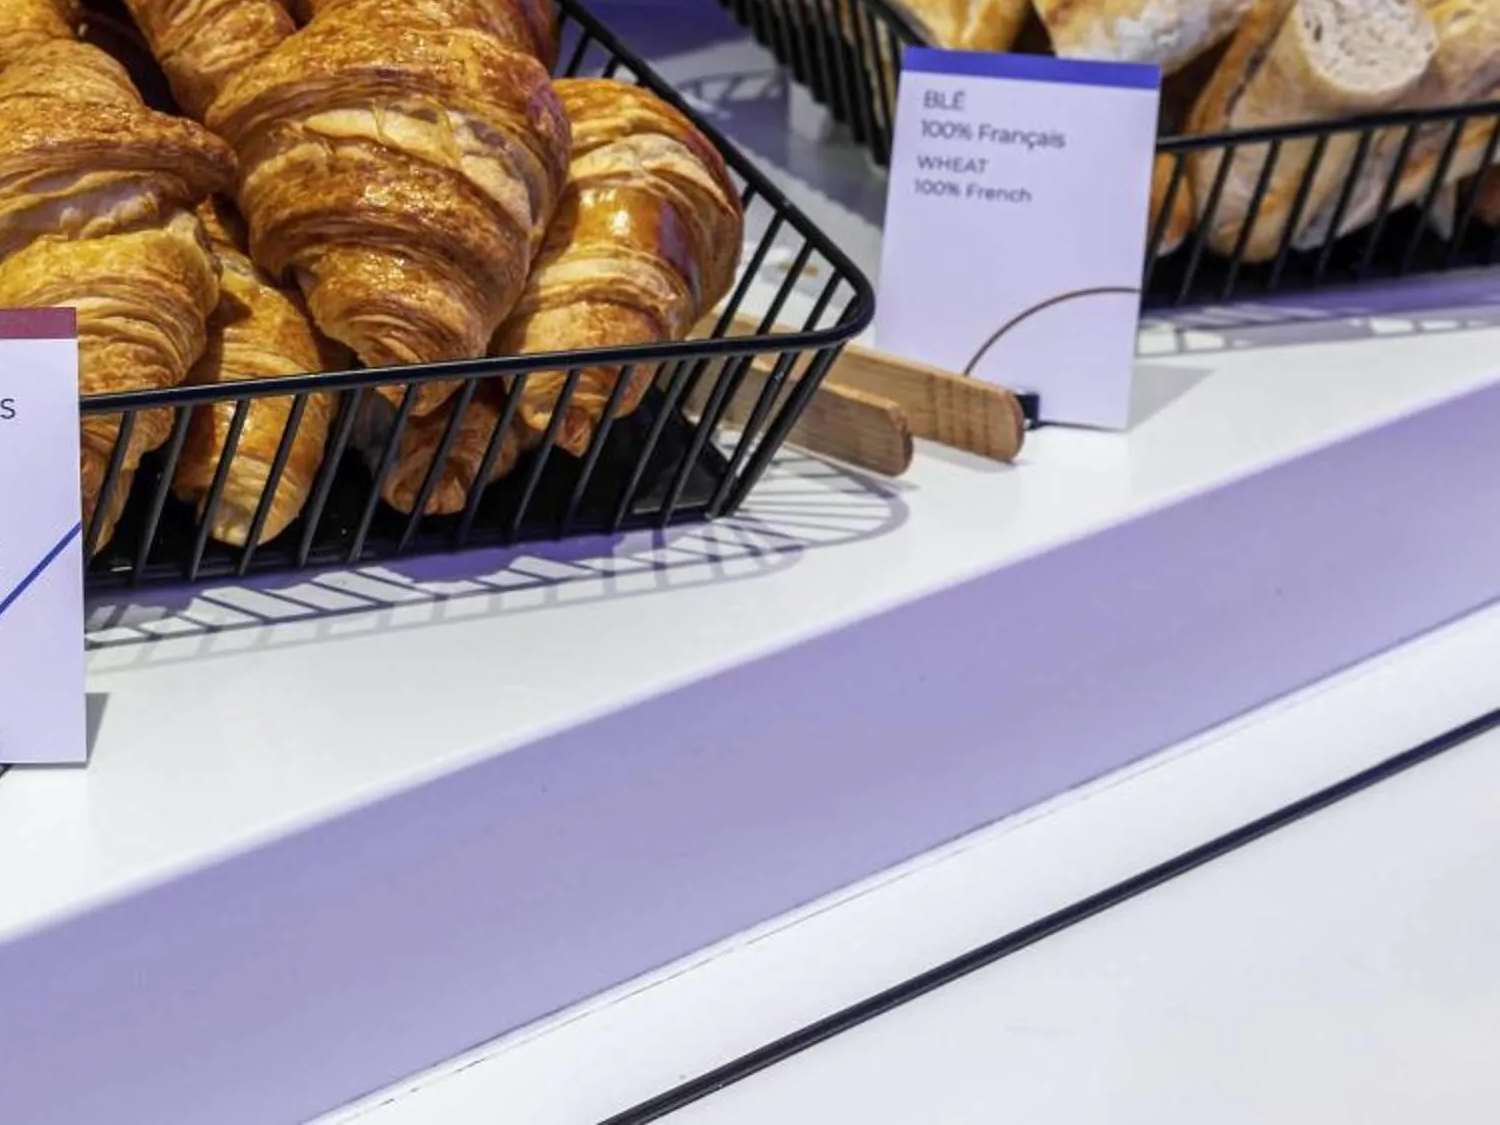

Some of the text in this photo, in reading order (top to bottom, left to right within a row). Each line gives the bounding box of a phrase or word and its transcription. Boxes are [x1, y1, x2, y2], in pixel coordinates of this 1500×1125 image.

[923, 89, 967, 111] BLÉ
[921, 119, 1066, 150] 100% Français
[916, 154, 989, 174] WHEAT
[914, 178, 1032, 203] 100% French
